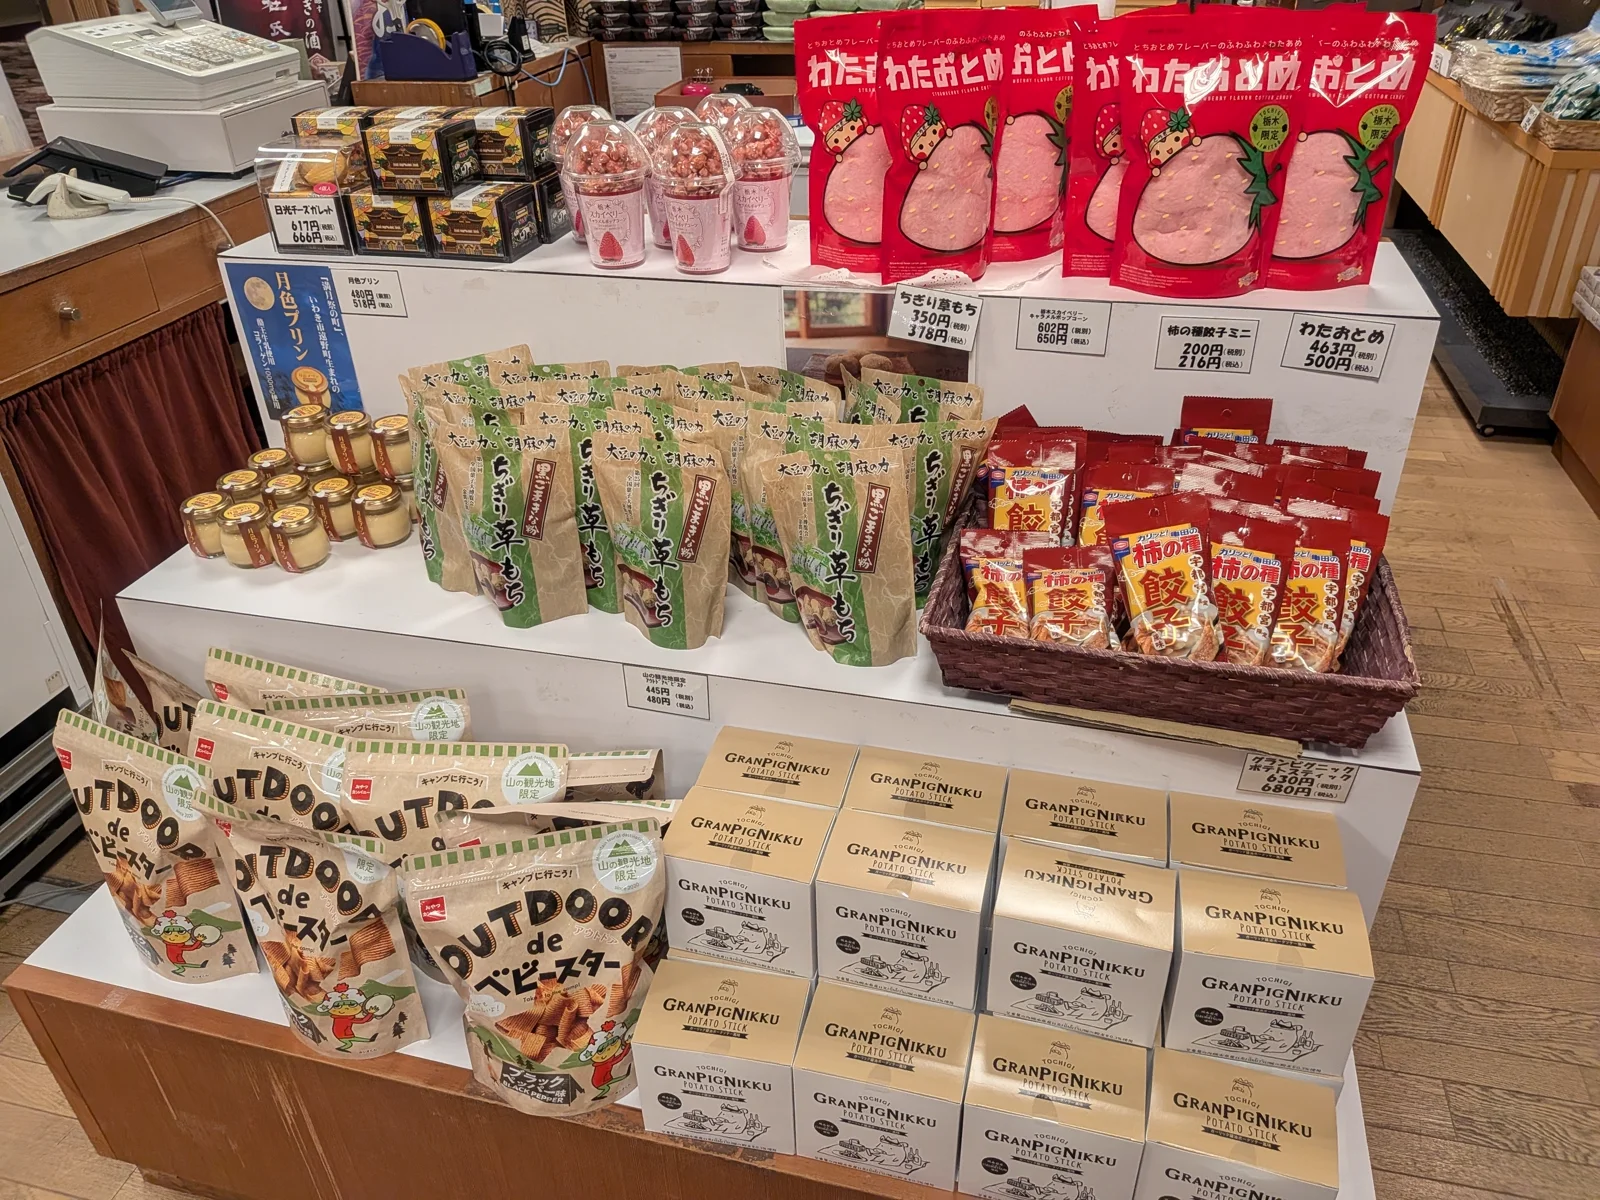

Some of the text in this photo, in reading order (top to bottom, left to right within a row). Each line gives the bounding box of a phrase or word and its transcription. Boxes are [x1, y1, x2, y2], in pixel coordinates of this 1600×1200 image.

[883, 48, 1004, 91] わたおとめ
[1263, 116, 1280, 126] 栃木
[1260, 130, 1279, 140] 限定
[274, 205, 334, 215] 日光チーズガレット
[348, 277, 380, 285] 月色プリン
[900, 291, 978, 317] ちぎり草もち
[275, 272, 308, 361] 月色プリン
[1167, 325, 1252, 339] 柿の種餃子ミニ
[1298, 321, 1385, 345] わたおとめ
[873, 378, 974, 407] 大豆の力と 胡麻の力
[447, 431, 557, 451] 大豆の力と 胡麻の力
[604, 444, 717, 468] 大豆の力と 胡麻の力
[777, 457, 890, 481] 大豆の力と 胡麻の力
[525, 462, 552, 536] 黒ごまきな粉
[491, 453, 525, 606] ちぎり草もち
[680, 479, 715, 560] 黒ごまきな粉
[857, 487, 888, 569] 黒ごまきな粉
[649, 470, 680, 627] ちぎり草もち
[1132, 533, 1202, 568] 柿の種
[823, 481, 858, 643] ちぎり草もち
[1212, 556, 1281, 586] 柿の種
[1043, 571, 1107, 587] 柿の種
[415, 719, 460, 731] 山の観光地
[428, 730, 449, 741] 限定
[253, 751, 307, 772] キャンプに行こう!
[767, 752, 794, 760] TOCHIGI
[1251, 756, 1355, 774] グランピグニック
[104, 764, 149, 787] キャンプに行こう!
[421, 774, 484, 788] キャンプに行こう!
[746, 765, 801, 780] POTATO STICK
[1248, 764, 1352, 781] ポテトスティック
[505, 778, 555, 789] 山の観光地
[518, 789, 540, 800] 限定
[107, 817, 130, 843] de
[1237, 822, 1271, 831] TOCHIGI
[1223, 838, 1290, 855] POTATO STICK
[597, 855, 652, 871] 山の観光地
[502, 868, 573, 891] キャンプに行こう!
[614, 868, 637, 882] 限定
[277, 883, 310, 909] de
[1254, 904, 1290, 914] TOCHIGI
[439, 887, 654, 981] OUTDOOR
[1240, 923, 1277, 937] POTATO
[1281, 928, 1312, 942] STICK
[526, 931, 564, 956] de
[473, 948, 622, 998] ベビースター
[1256, 976, 1293, 987] TOCHIGI
[710, 995, 740, 1005] TOCHIGI
[1233, 993, 1305, 1012] POTATO STICK
[687, 1015, 720, 1029] POTATO
[721, 1018, 748, 1033] STICK
[872, 1022, 904, 1034] TOCHIGI
[851, 1041, 915, 1064] POTATO STICK
[1041, 1059, 1075, 1070] TOCHIGI
[502, 1071, 567, 1099] ペッパー味
[508, 1064, 566, 1088] ブラック
[502, 1079, 564, 1104] BLACK PEPPER
[1022, 1078, 1091, 1102] POTATO STICK
[1224, 1095, 1260, 1109] TOCHIGI
[1206, 1115, 1278, 1143] POTATO STICK
